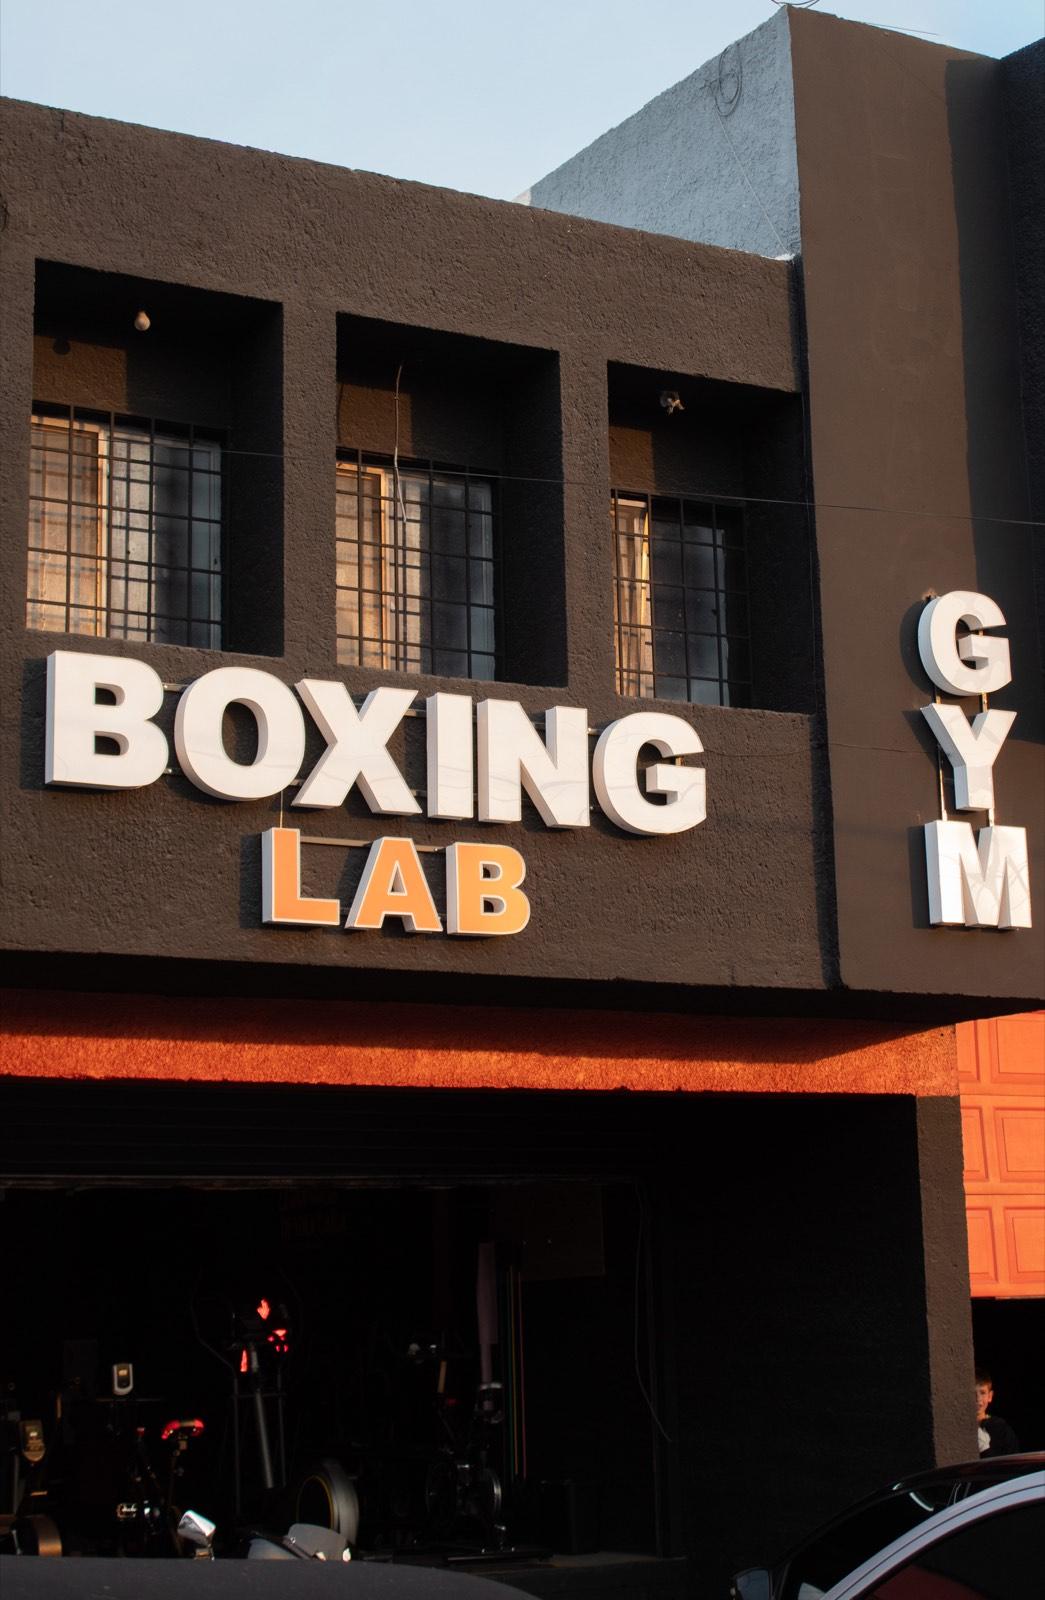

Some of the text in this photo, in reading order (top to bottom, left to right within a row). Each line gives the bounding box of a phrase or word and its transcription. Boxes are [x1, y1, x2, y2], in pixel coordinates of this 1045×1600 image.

[45, 651, 706, 835] BOXING
[917, 590, 1032, 929] GYM
[262, 827, 531, 936] LAB
